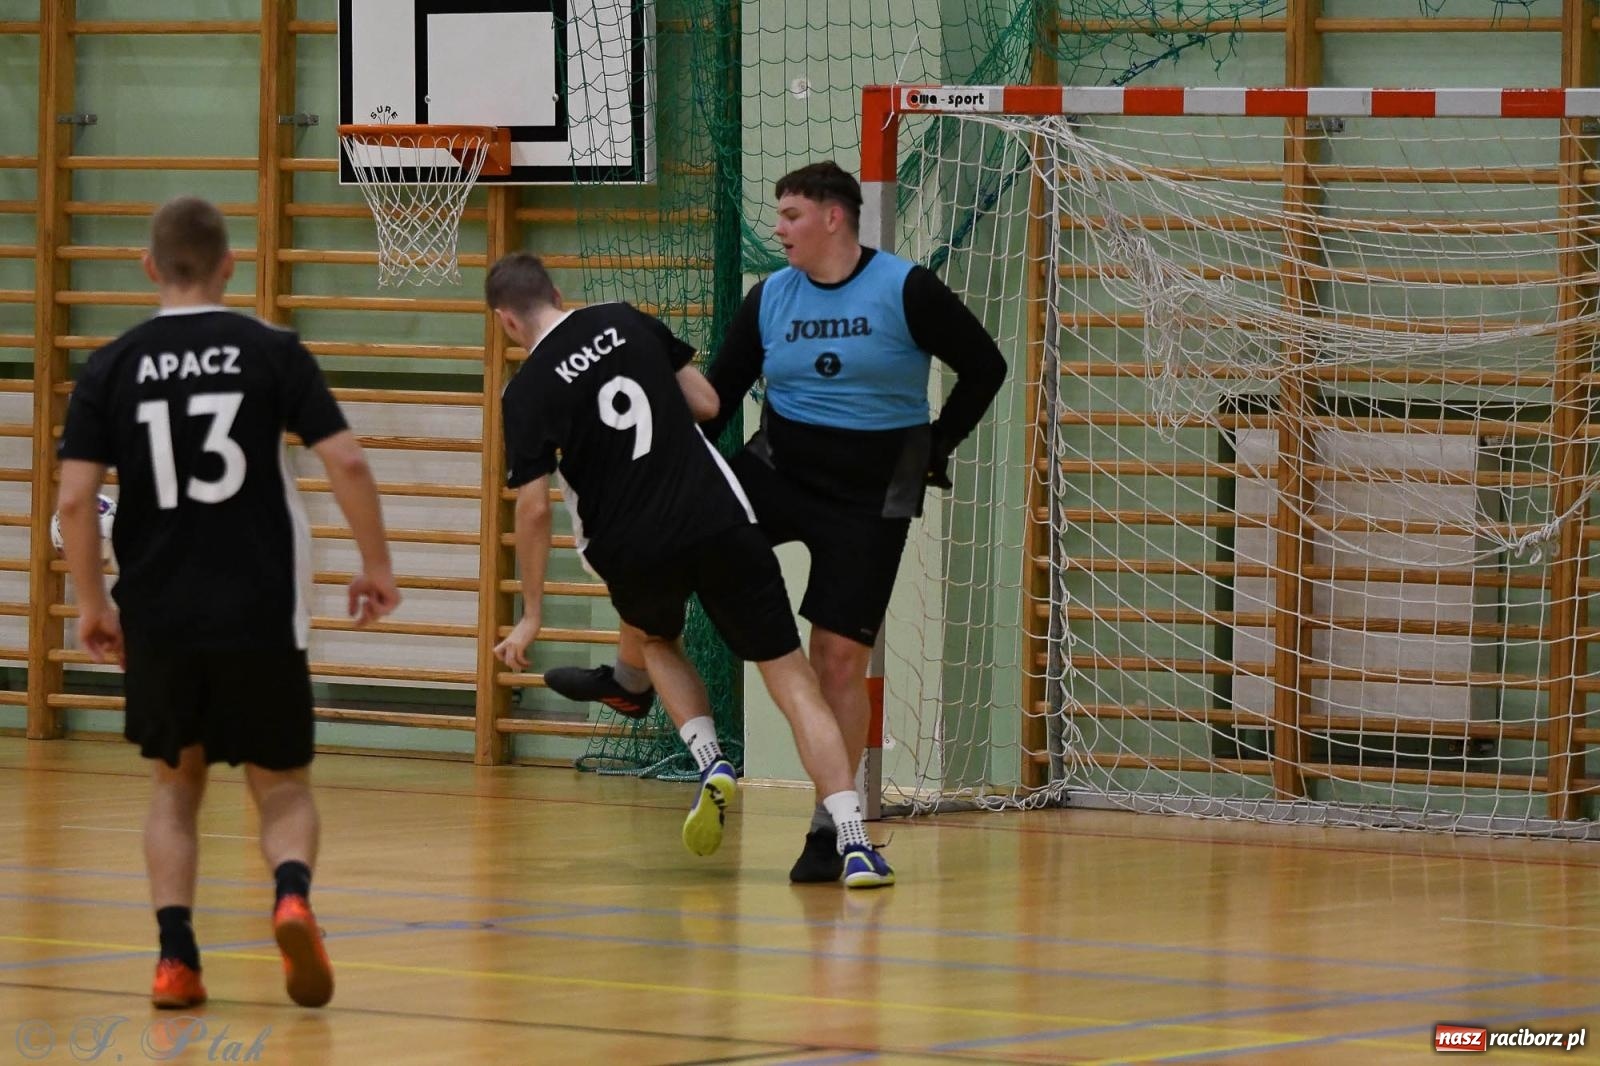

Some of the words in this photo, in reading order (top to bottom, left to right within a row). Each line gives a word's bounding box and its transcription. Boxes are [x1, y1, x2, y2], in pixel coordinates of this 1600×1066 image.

[370, 105, 398, 120] SURE
[136, 345, 242, 385] APACZ
[554, 327, 627, 384] KOŁCZ
[597, 374, 653, 461] 9
[135, 392, 247, 510] 13
